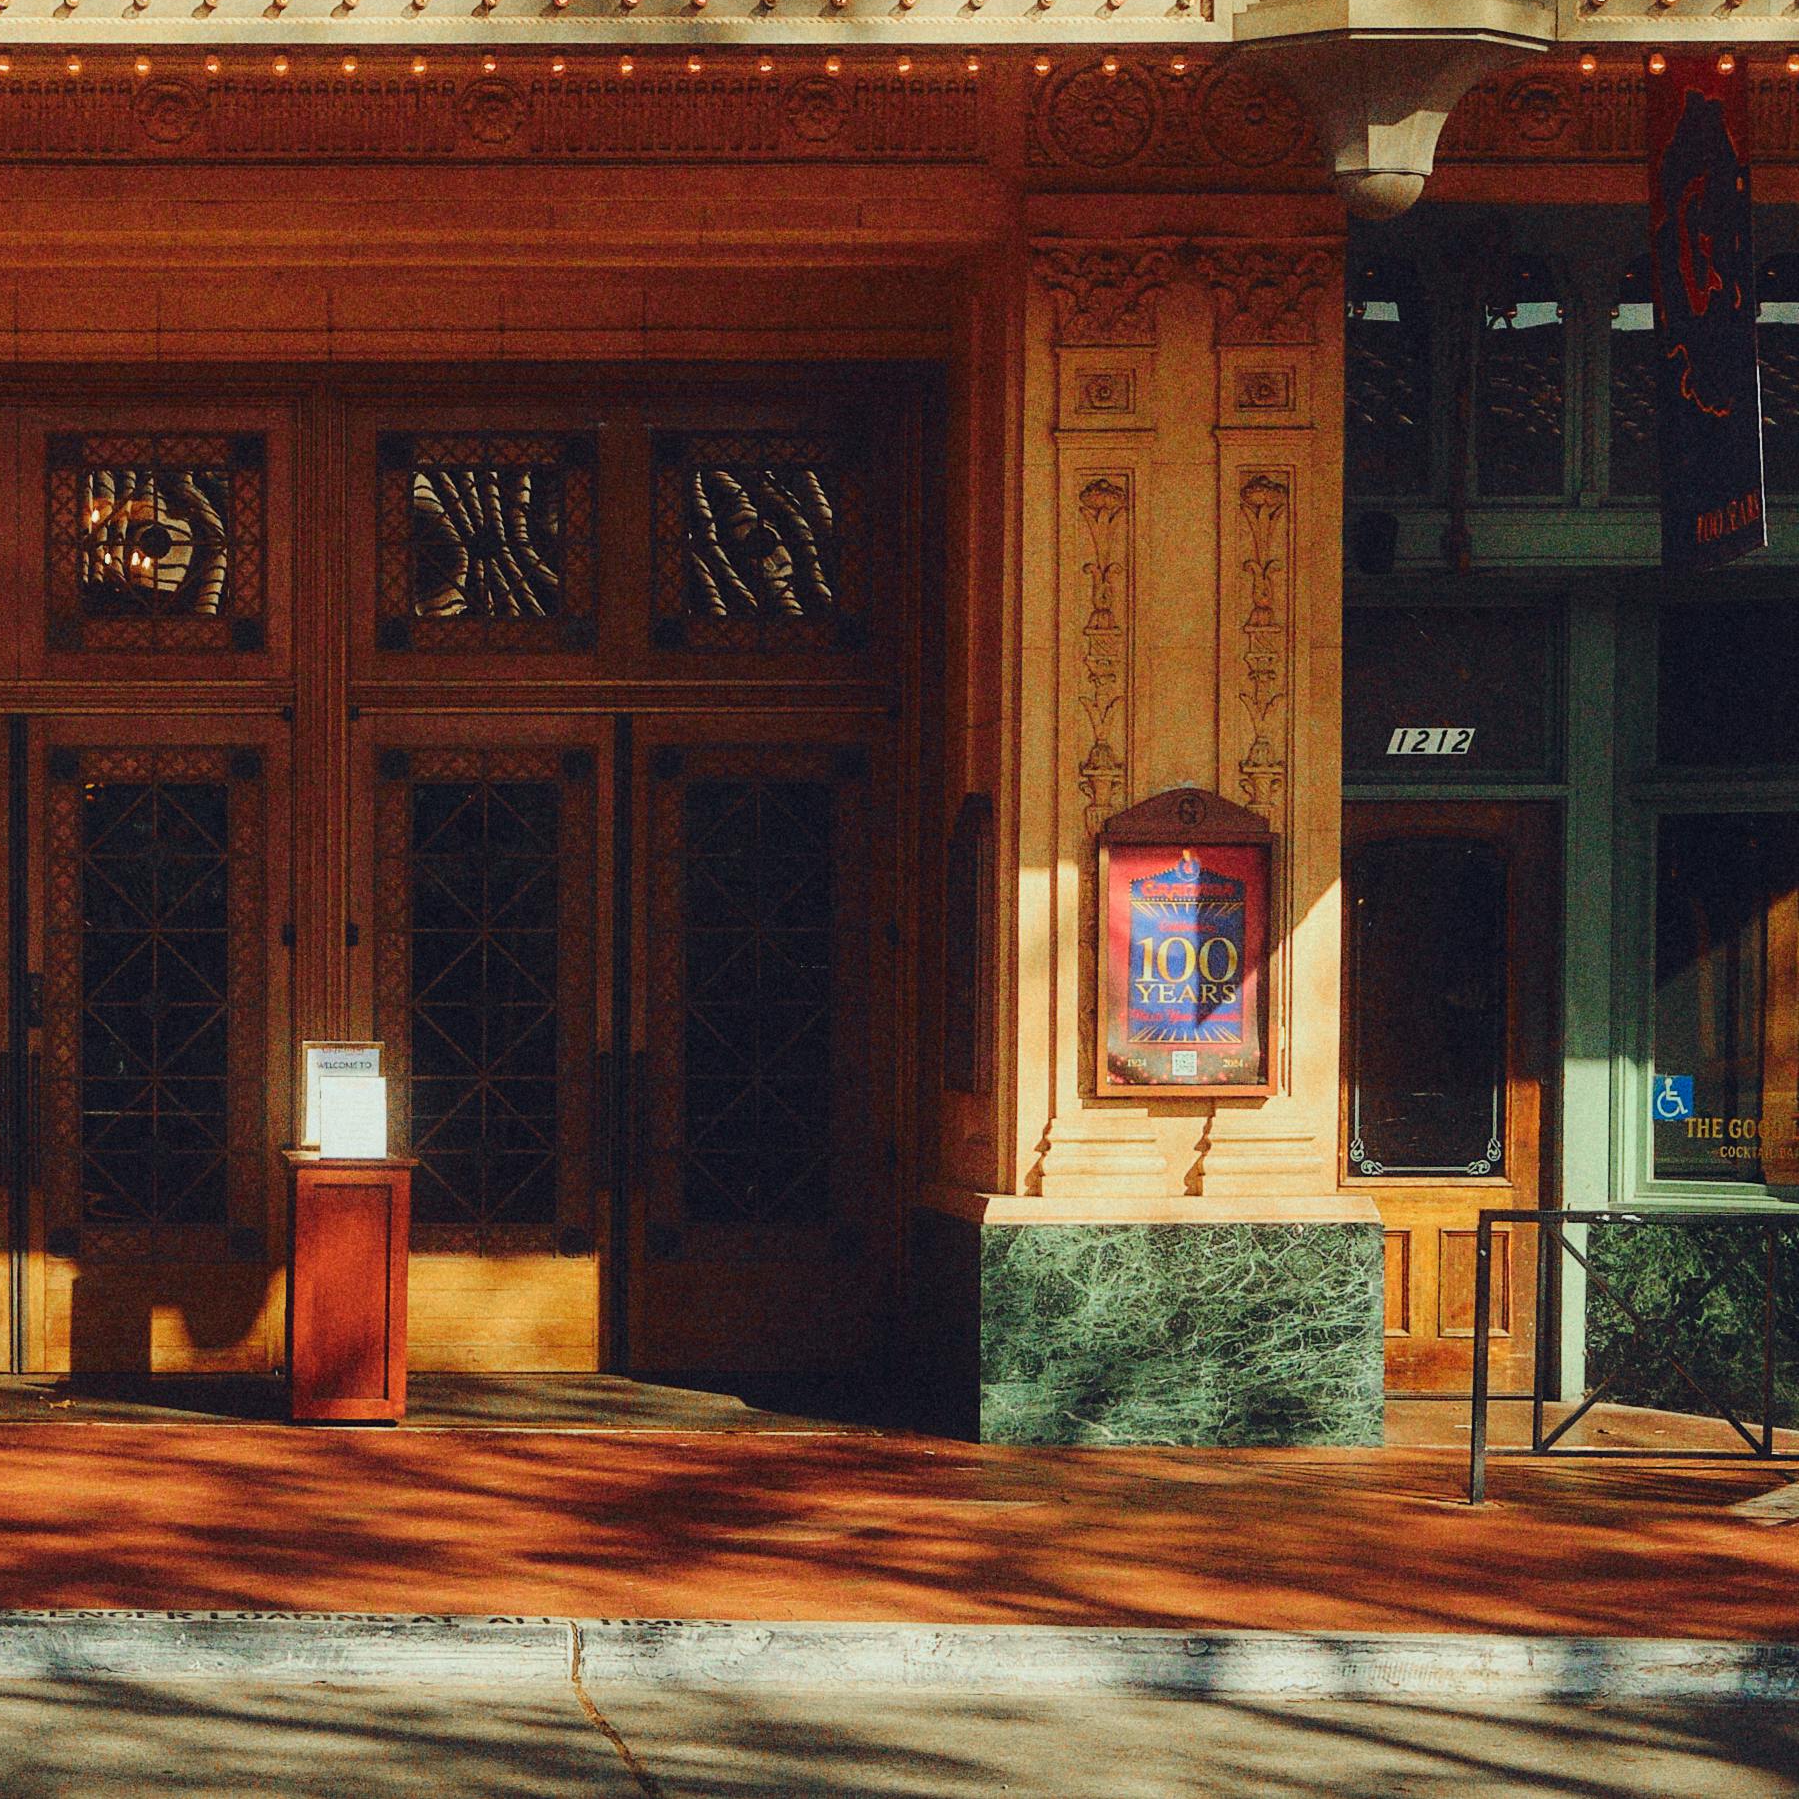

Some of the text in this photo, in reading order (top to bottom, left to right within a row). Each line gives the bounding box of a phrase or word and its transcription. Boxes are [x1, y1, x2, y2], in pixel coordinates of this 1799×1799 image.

[1396, 729, 1471, 752] 1212
[1135, 936, 1238, 983] 100
[1134, 983, 1237, 1004] YEARS
[360, 1061, 372, 1070] TO
[1685, 1117, 1724, 1138] THE
[208, 1612, 394, 1623] LOADING
